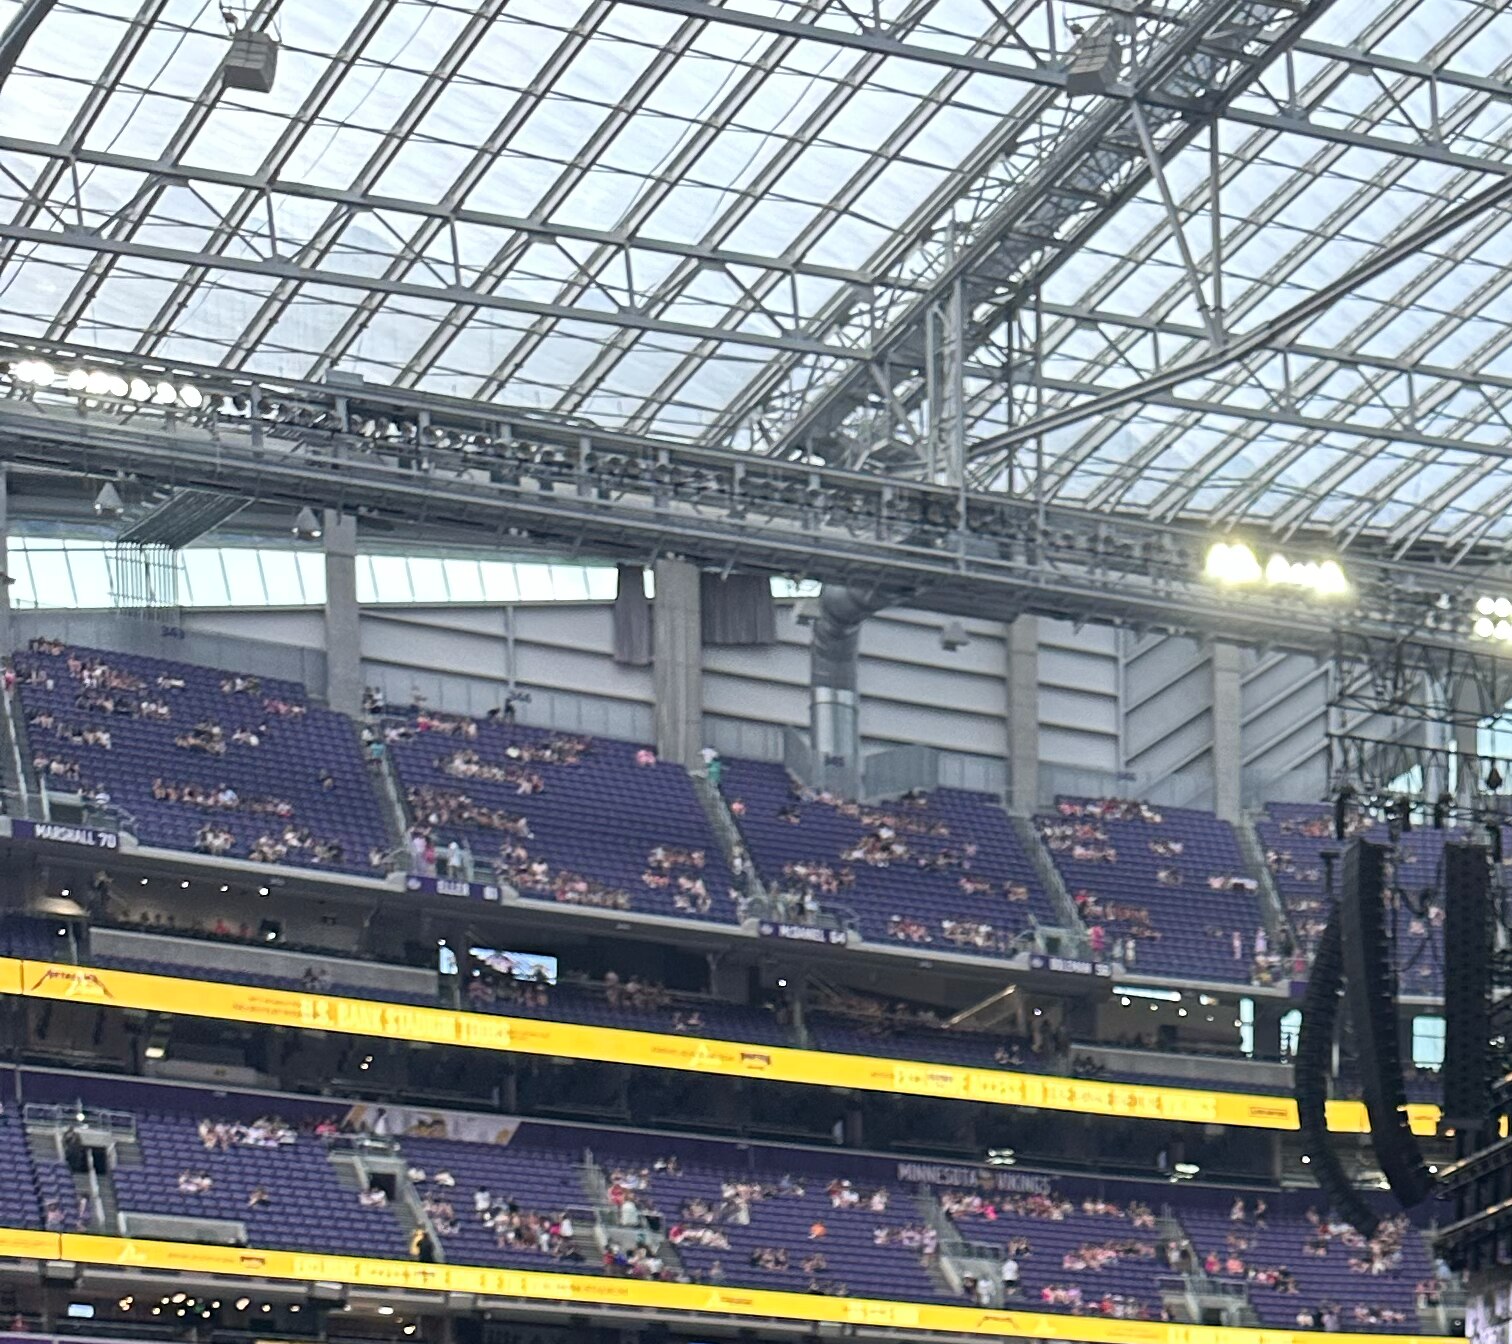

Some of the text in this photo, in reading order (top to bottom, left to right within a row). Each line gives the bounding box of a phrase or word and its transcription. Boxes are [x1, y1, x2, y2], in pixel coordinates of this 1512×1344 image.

[97, 831, 117, 849] 70
[897, 1162, 1051, 1195] MINNESOTA VIKINGS
